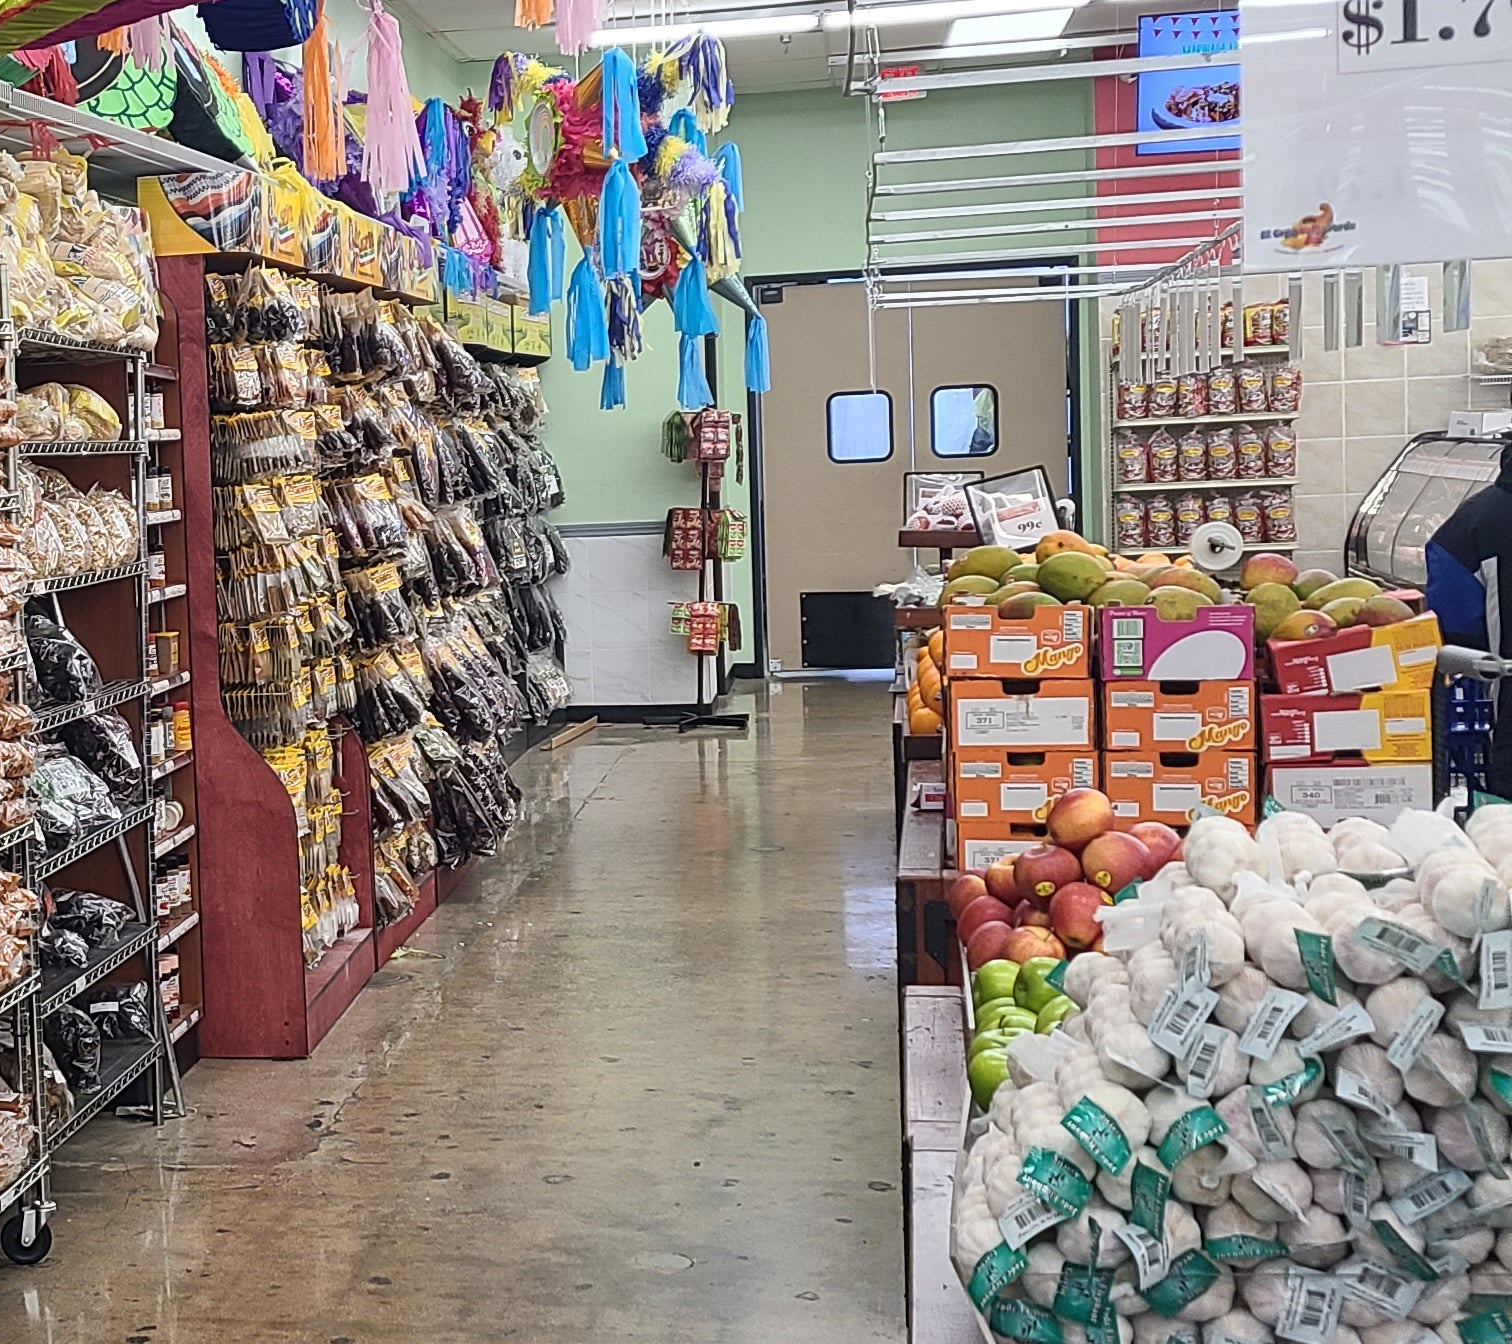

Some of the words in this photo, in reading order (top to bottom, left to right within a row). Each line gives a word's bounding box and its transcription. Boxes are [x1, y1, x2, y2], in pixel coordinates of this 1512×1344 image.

[1023, 643, 1082, 673] Mango
[1187, 720, 1249, 751] Mango
[1302, 791, 1321, 799] 340
